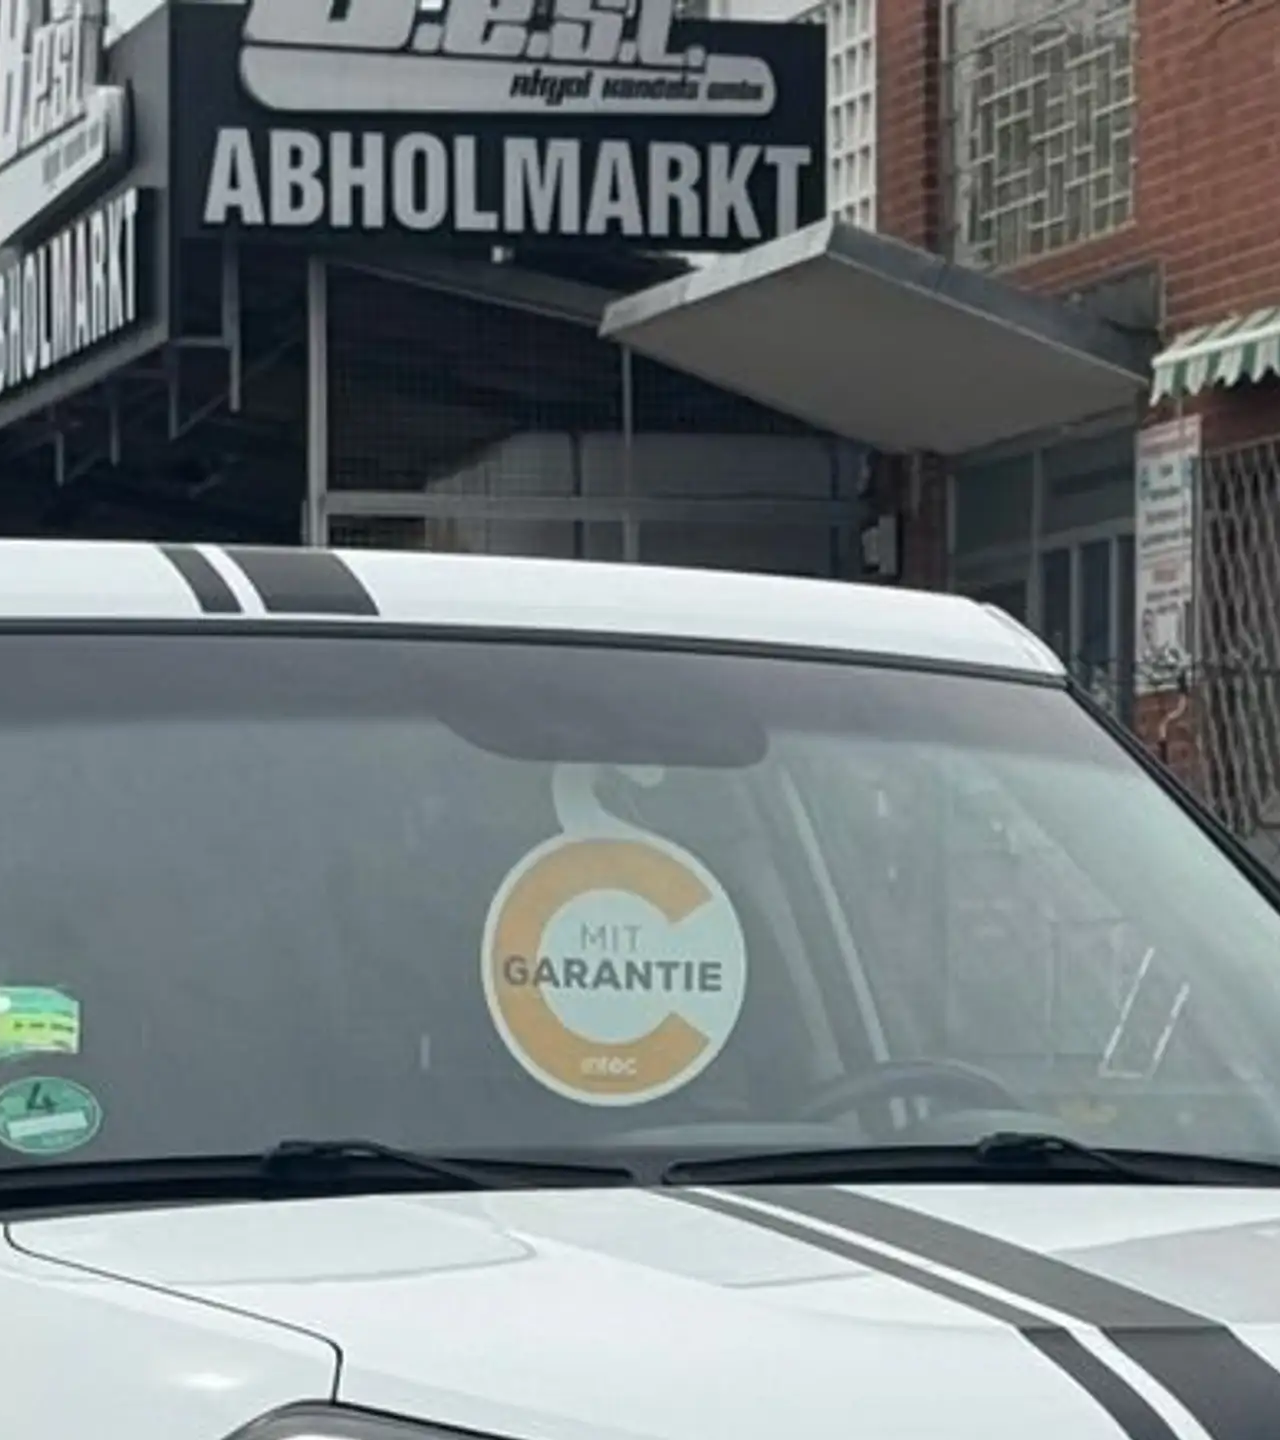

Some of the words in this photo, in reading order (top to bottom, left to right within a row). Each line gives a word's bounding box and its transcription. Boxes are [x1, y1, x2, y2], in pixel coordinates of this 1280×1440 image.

[203, 126, 812, 240] ABHOLMARKT
[579, 922, 643, 951] MIT
[503, 954, 723, 992] GARANTIE
[26, 1082, 60, 1113] 4
